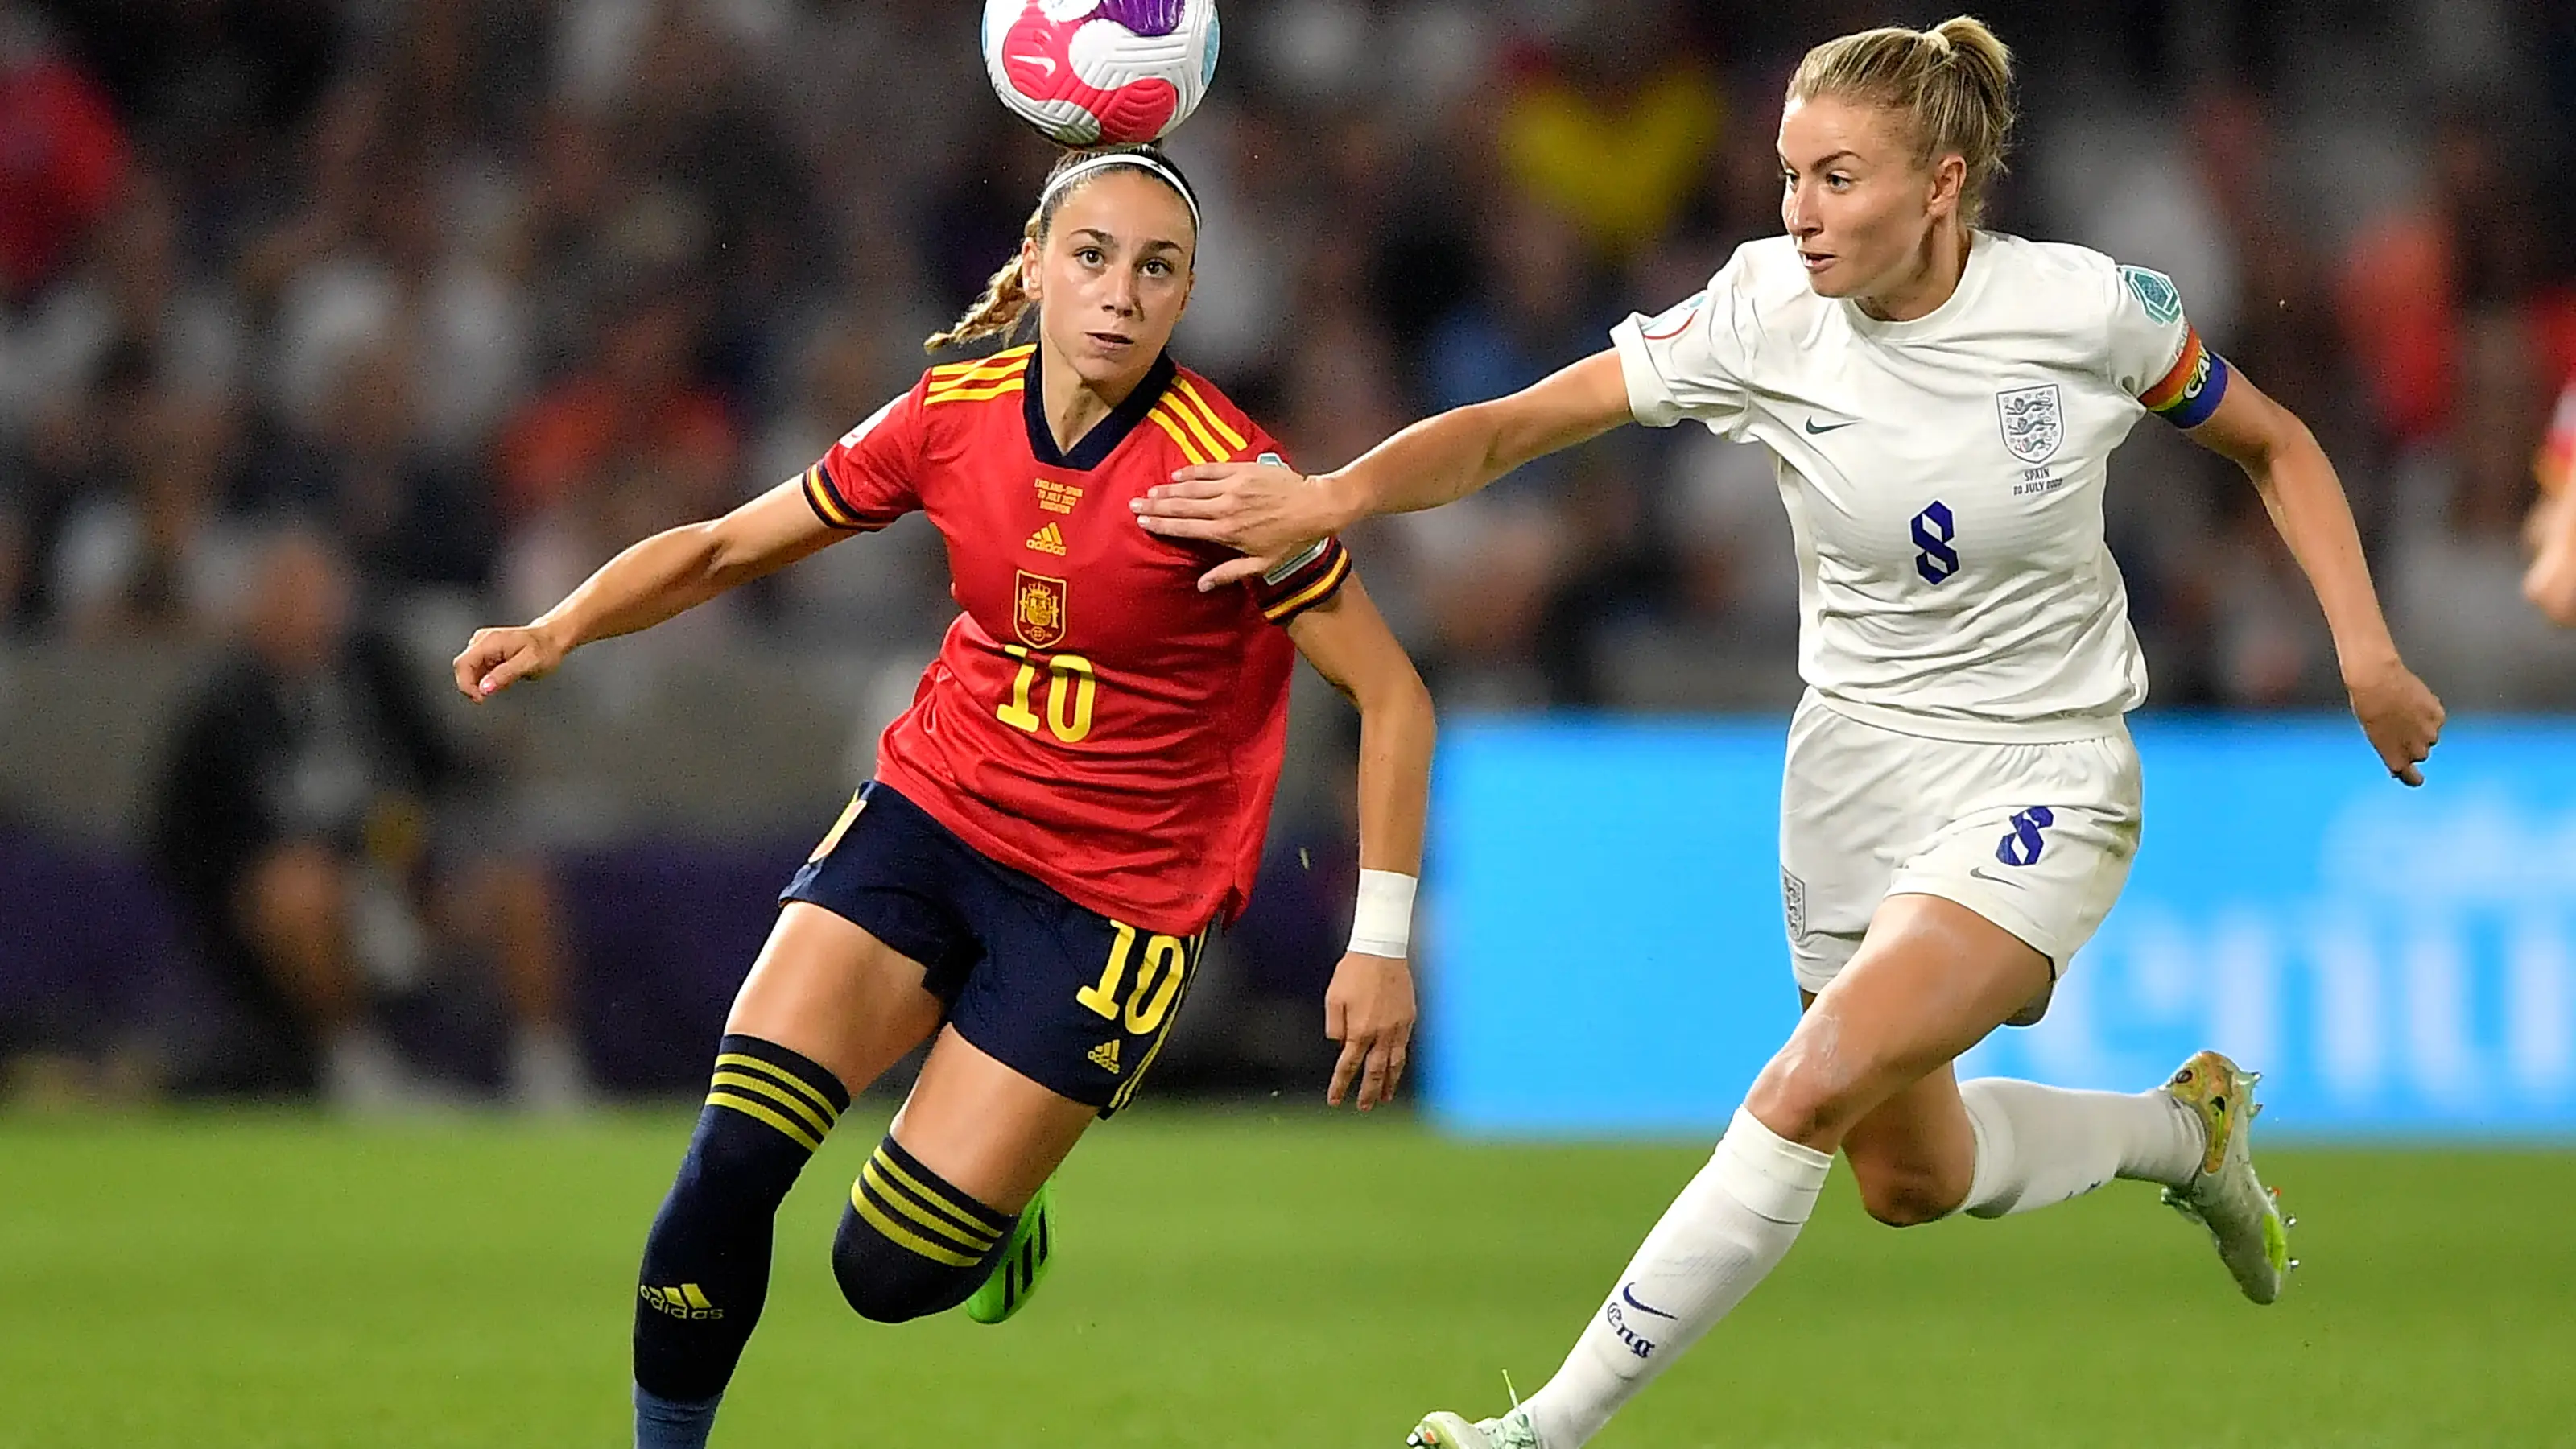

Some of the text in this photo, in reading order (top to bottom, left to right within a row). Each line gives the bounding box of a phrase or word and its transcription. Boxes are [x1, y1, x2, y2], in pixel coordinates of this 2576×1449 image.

[2024, 481, 2045, 494] JULY
[2025, 468, 2050, 481] SPAIN
[1026, 539, 1067, 556] adidas
[1910, 500, 1959, 585] 8
[996, 644, 1096, 743] 10
[1995, 805, 2054, 867] 8
[1075, 919, 1185, 1035] 10
[640, 1284, 724, 1319] adidas
[1607, 1302, 1655, 1358] Eng
